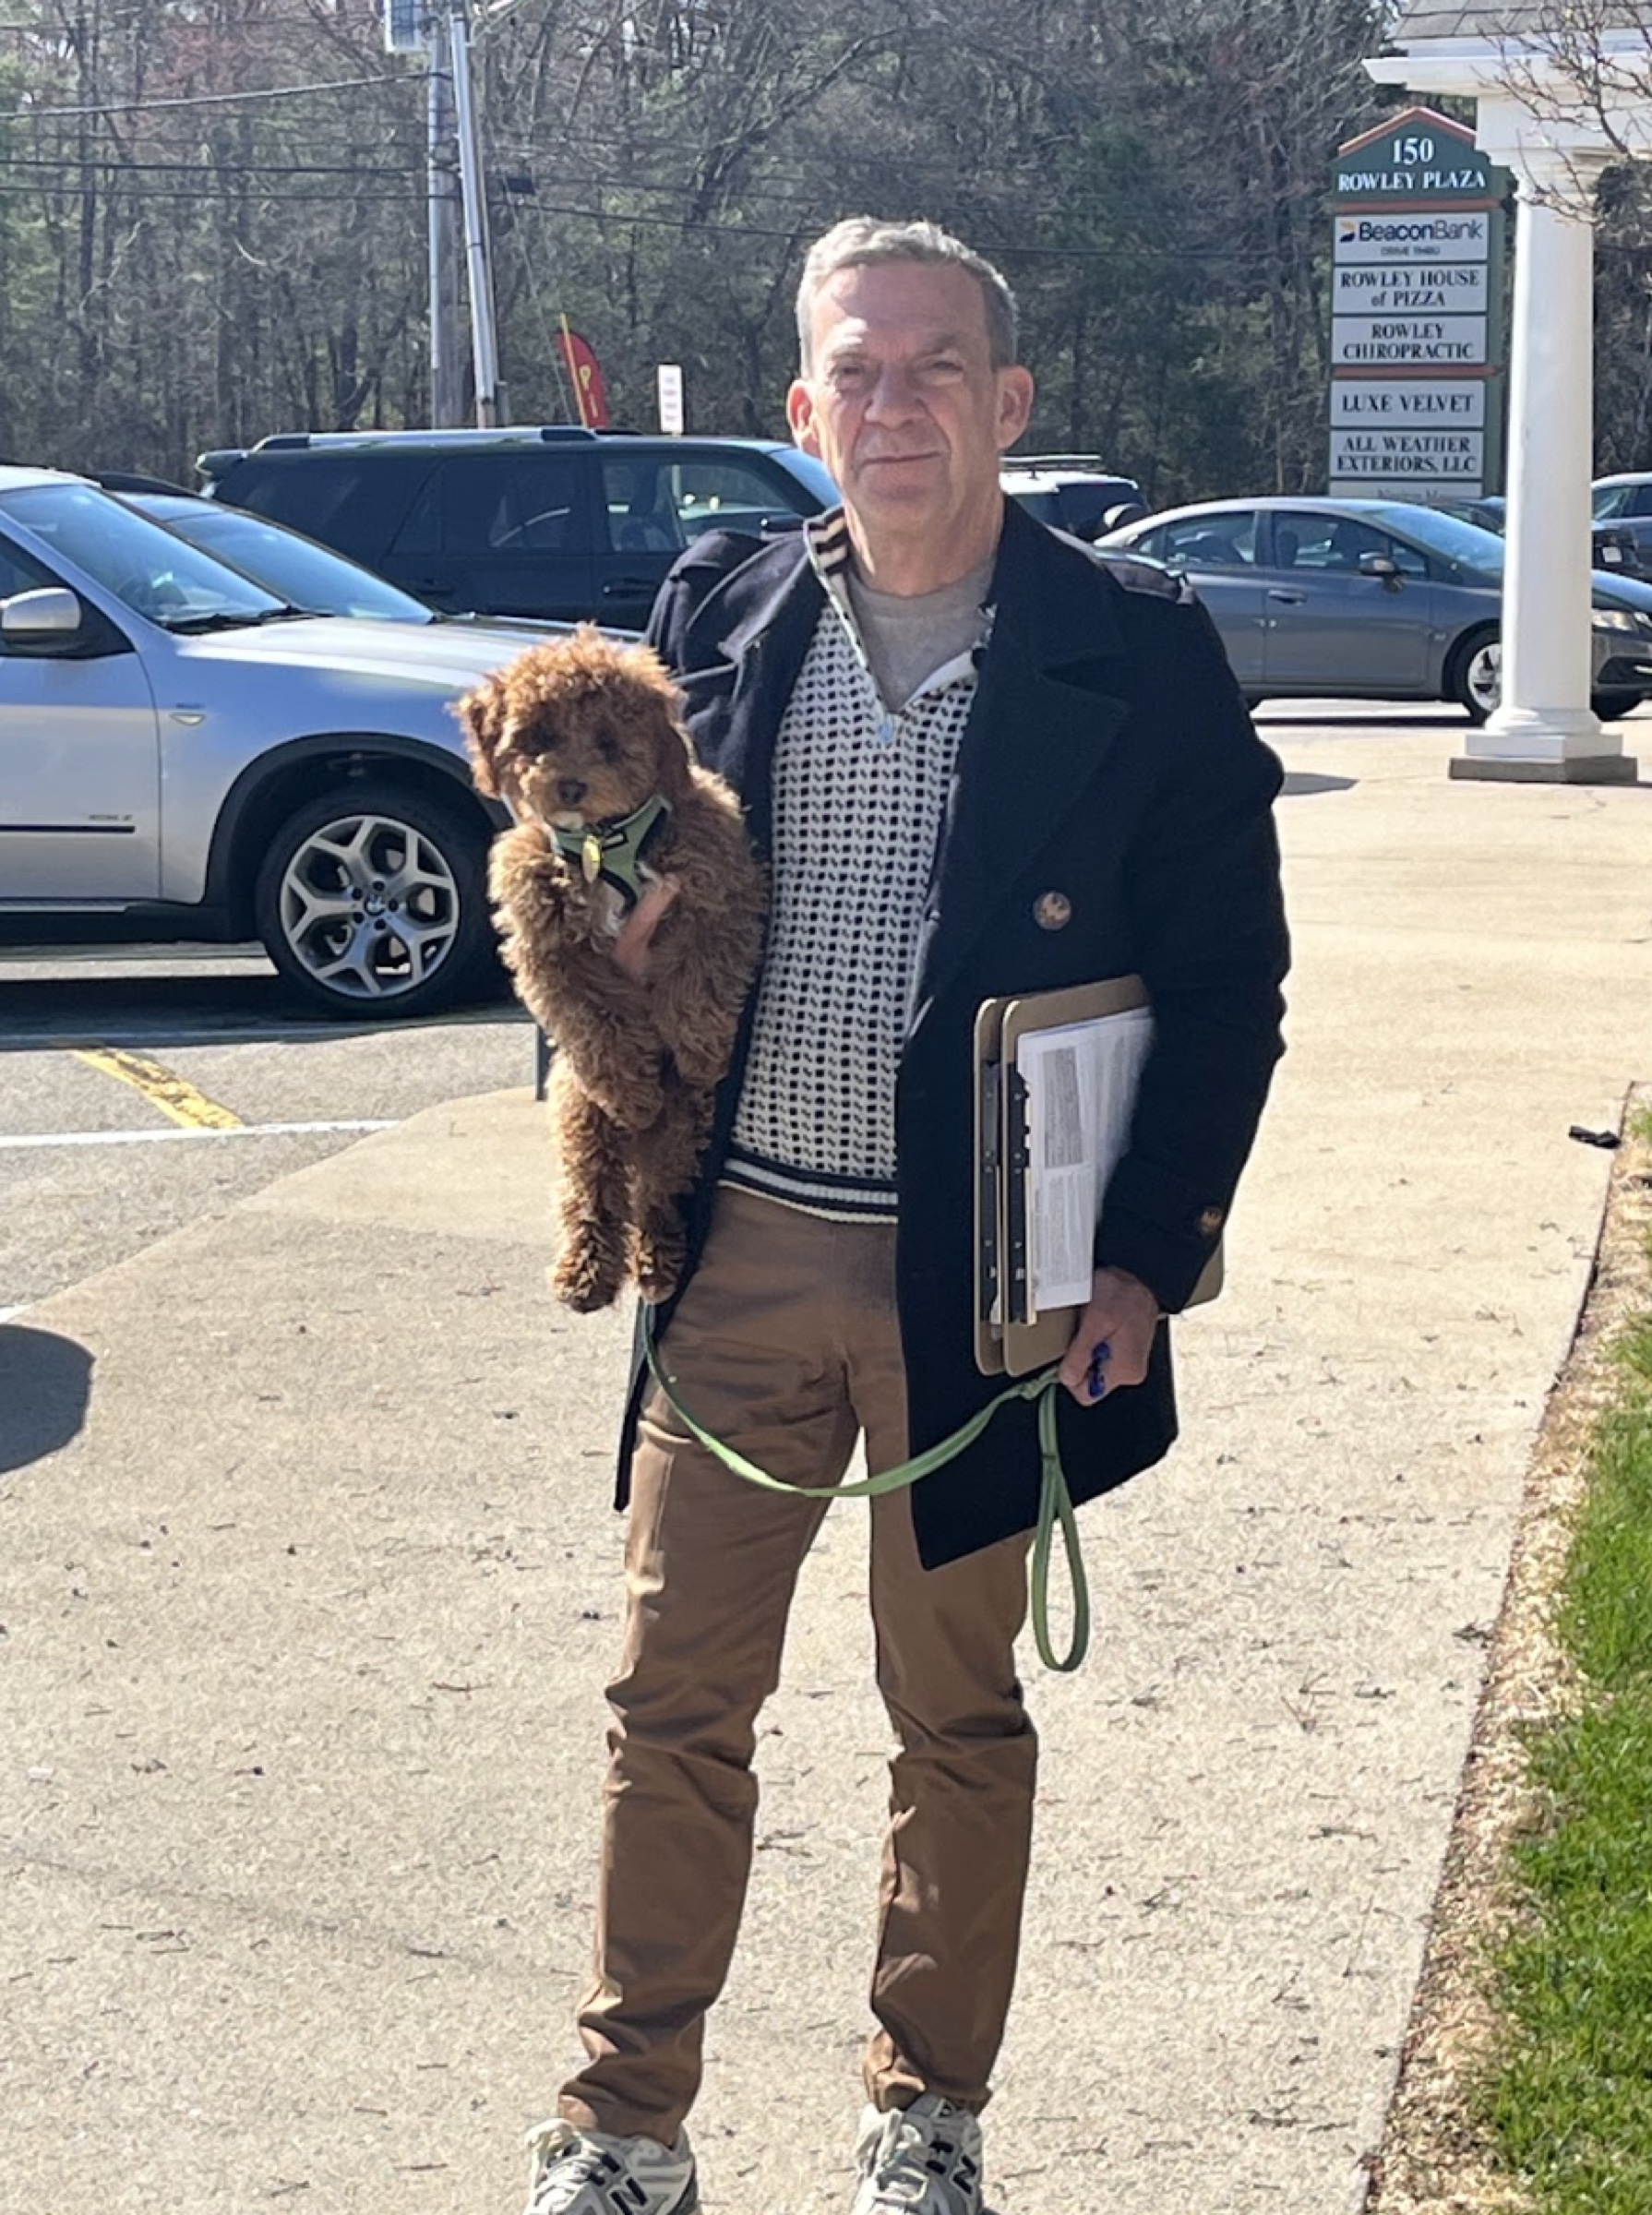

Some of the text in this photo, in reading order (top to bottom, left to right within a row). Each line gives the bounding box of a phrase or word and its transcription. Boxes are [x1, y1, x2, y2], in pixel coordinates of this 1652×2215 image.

[1394, 138, 1434, 165] 150
[1338, 170, 1486, 191] ROWLEY PLAZA
[1359, 219, 1483, 242] BeaconBank
[1340, 269, 1479, 288] ROWLEY HOUSE
[1371, 290, 1445, 306] of PIZZA
[1371, 323, 1445, 340] ROWLEY
[1342, 342, 1474, 360] CHIROPRACTIC
[1342, 394, 1474, 413] LUXE VELVET
[1343, 437, 1471, 452] ALL WEATHER
[1336, 455, 1477, 473] EXTERIORS, LLC
